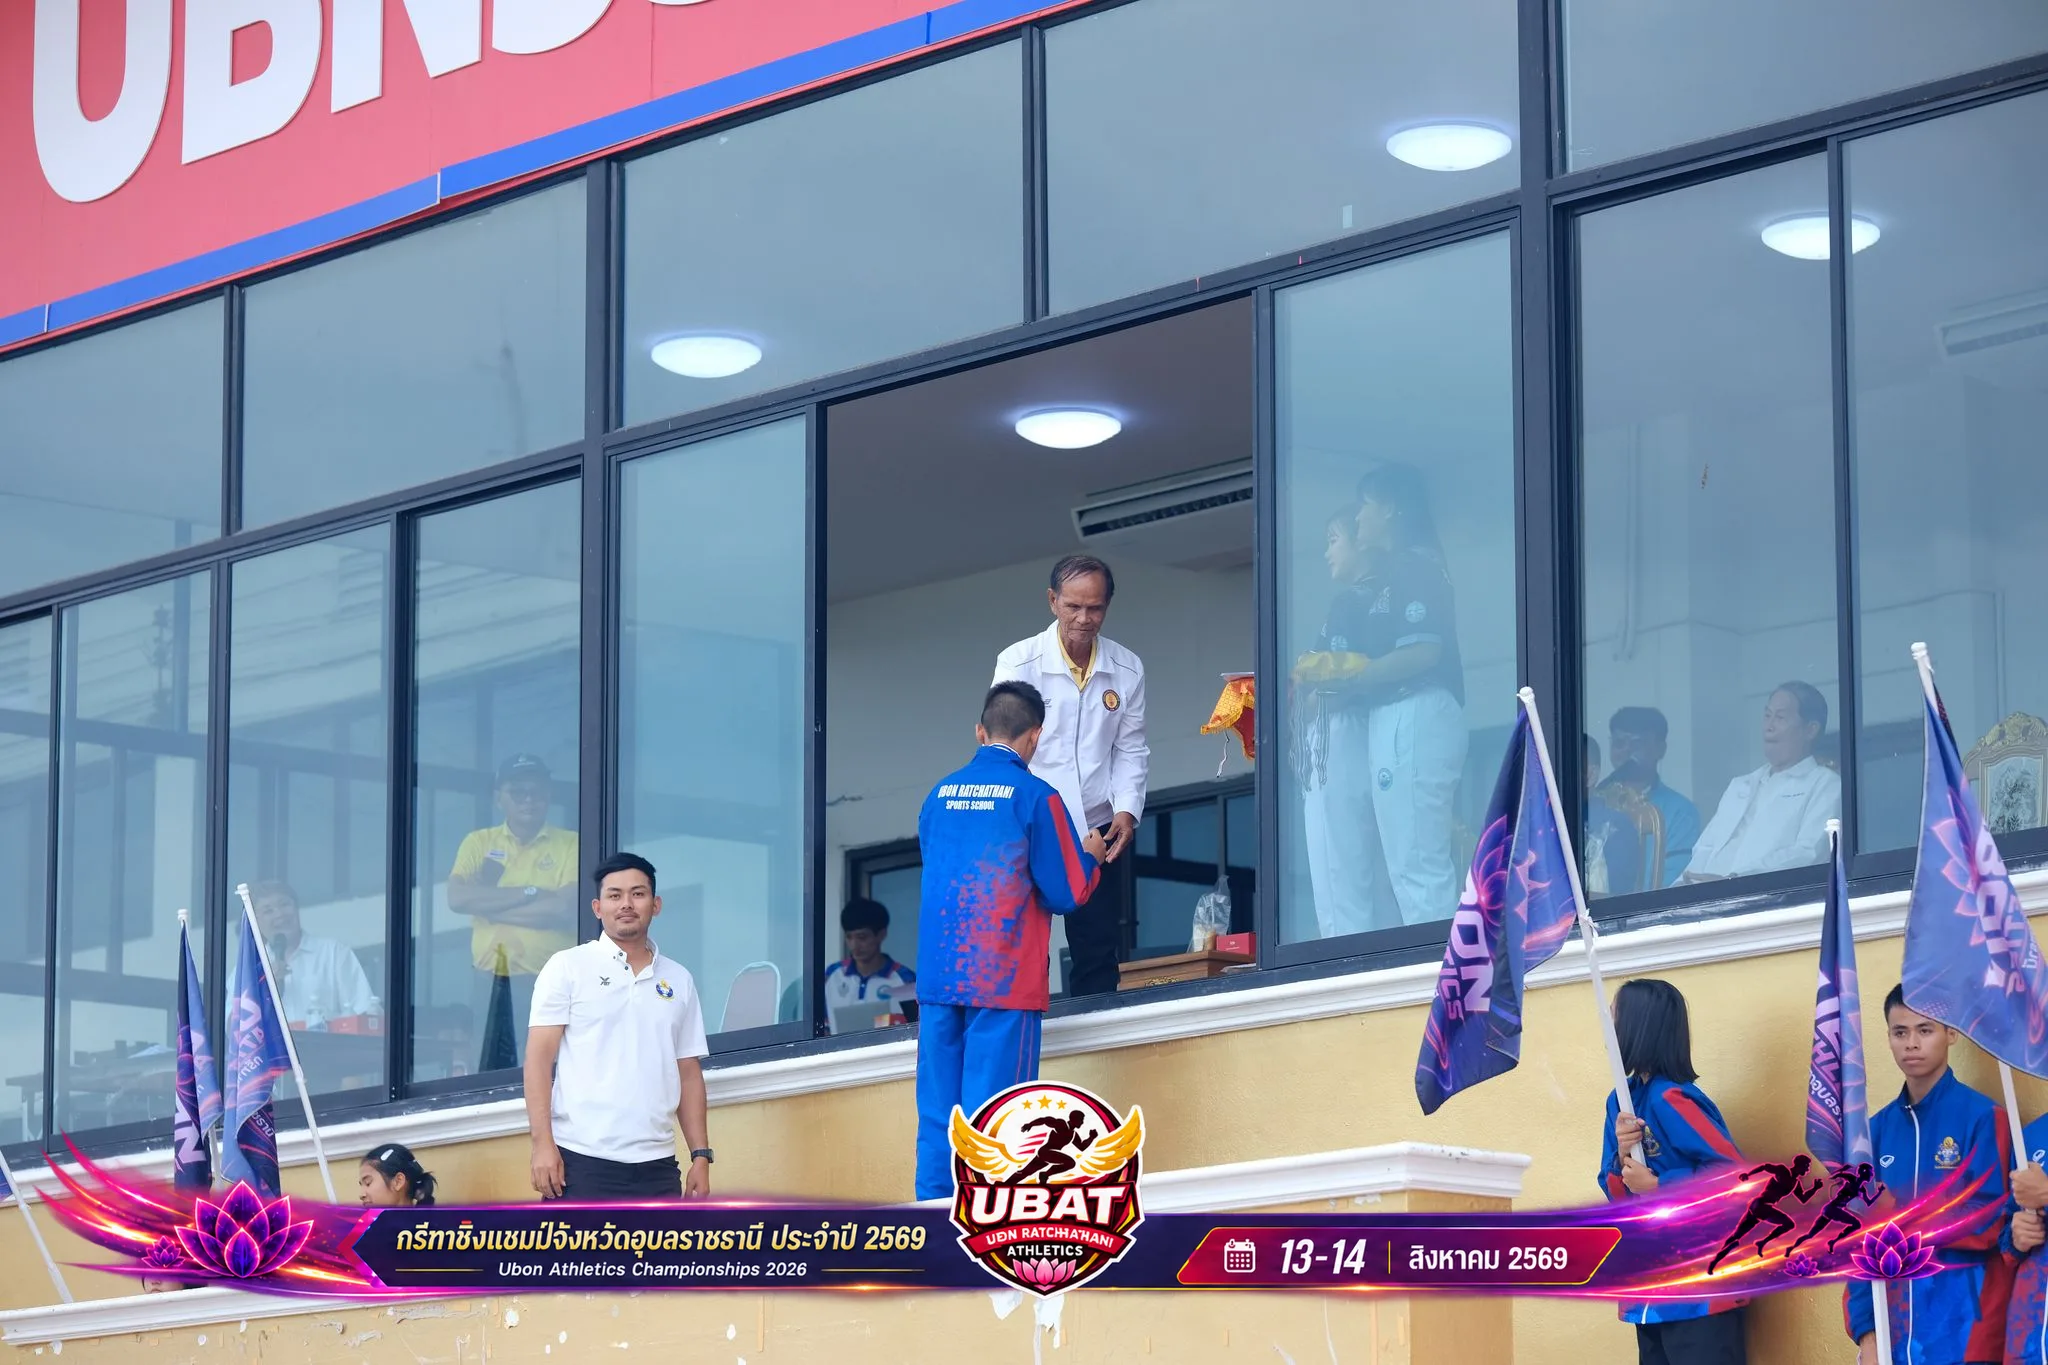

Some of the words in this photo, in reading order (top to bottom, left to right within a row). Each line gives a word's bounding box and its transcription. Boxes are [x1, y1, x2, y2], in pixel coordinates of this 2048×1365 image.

[957, 784, 1015, 799] RATCHATHANI
[946, 800, 970, 810] SPORTS
[970, 800, 995, 811] SCHOOL
